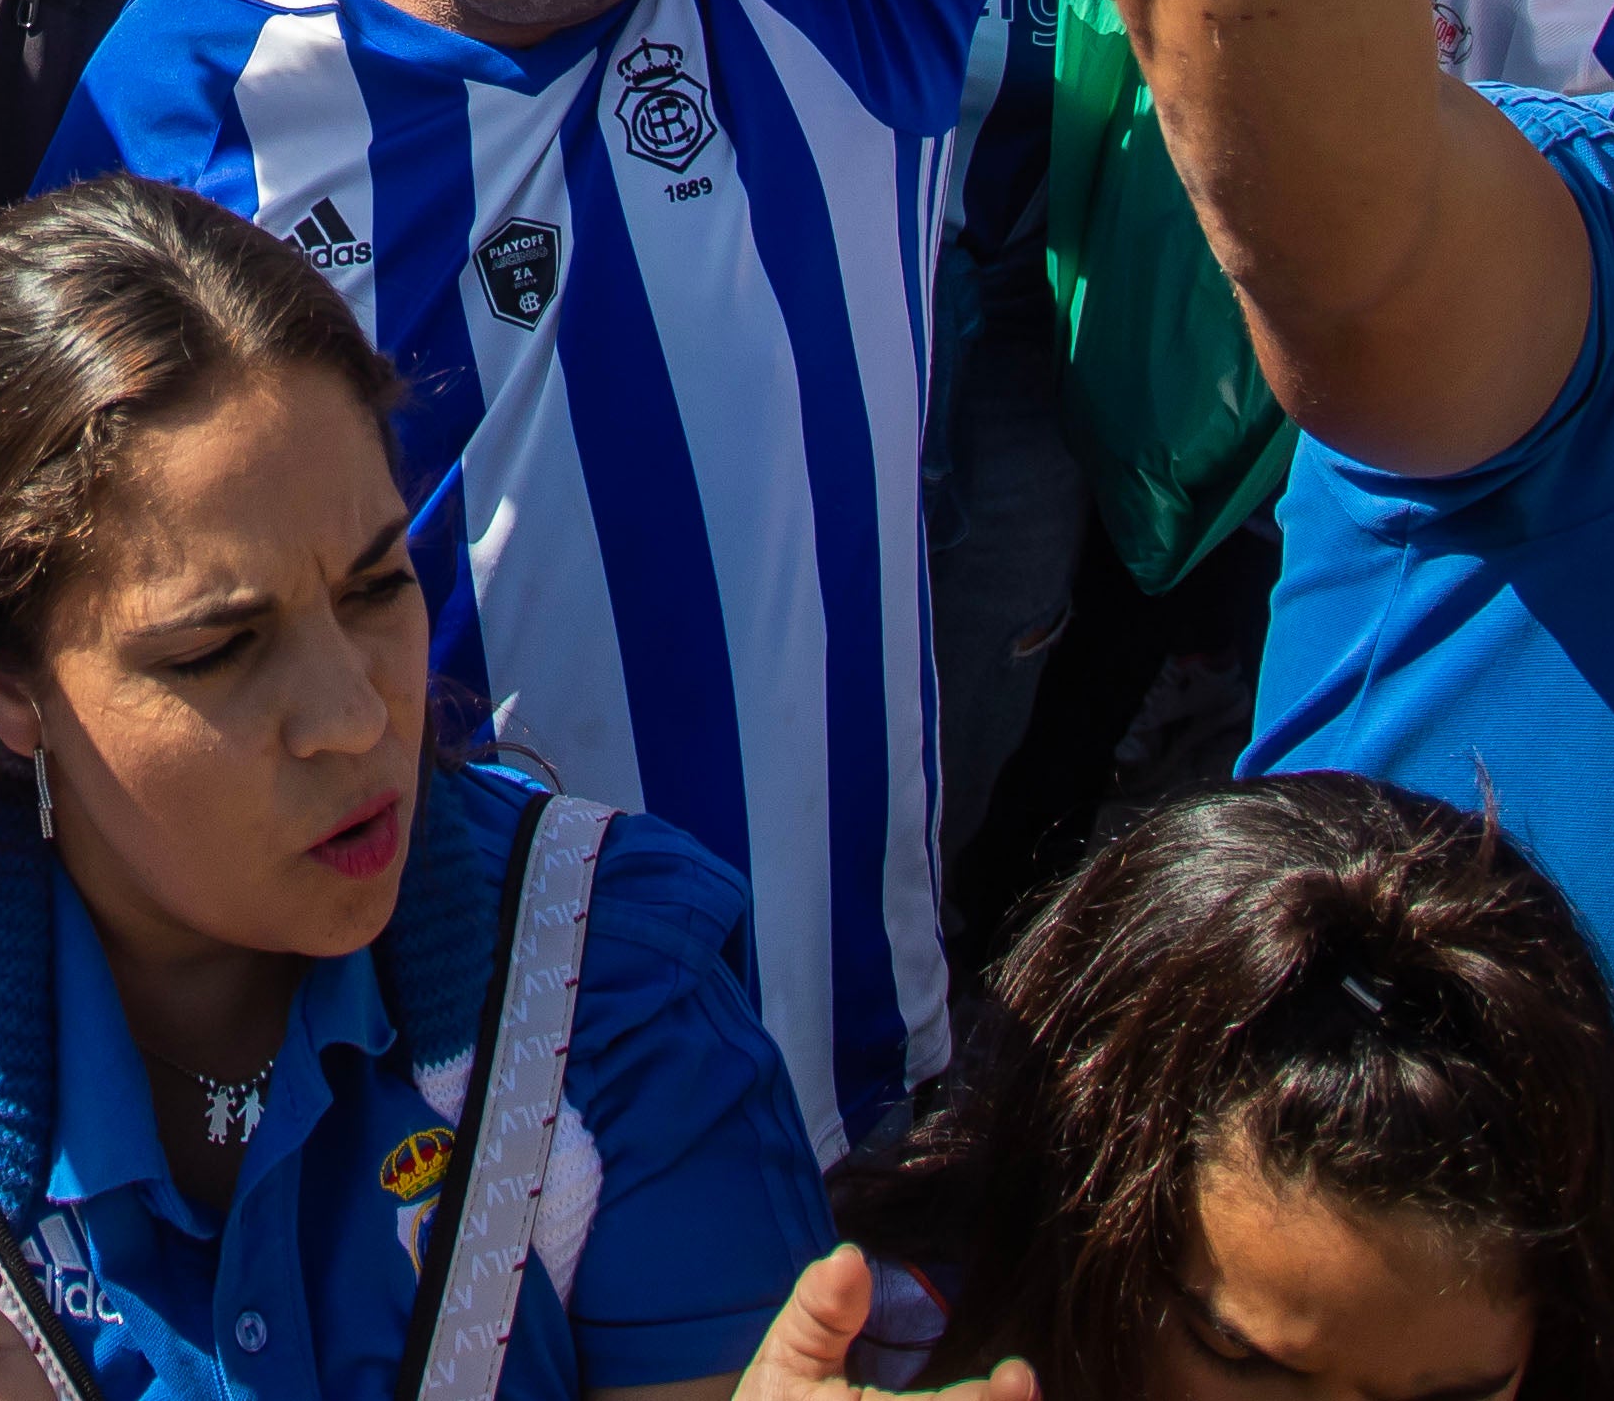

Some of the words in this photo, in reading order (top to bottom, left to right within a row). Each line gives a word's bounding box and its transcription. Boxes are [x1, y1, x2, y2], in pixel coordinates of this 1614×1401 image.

[663, 174, 713, 204] 1889
[303, 239, 373, 269] das
[488, 233, 546, 260] PLAYOFF
